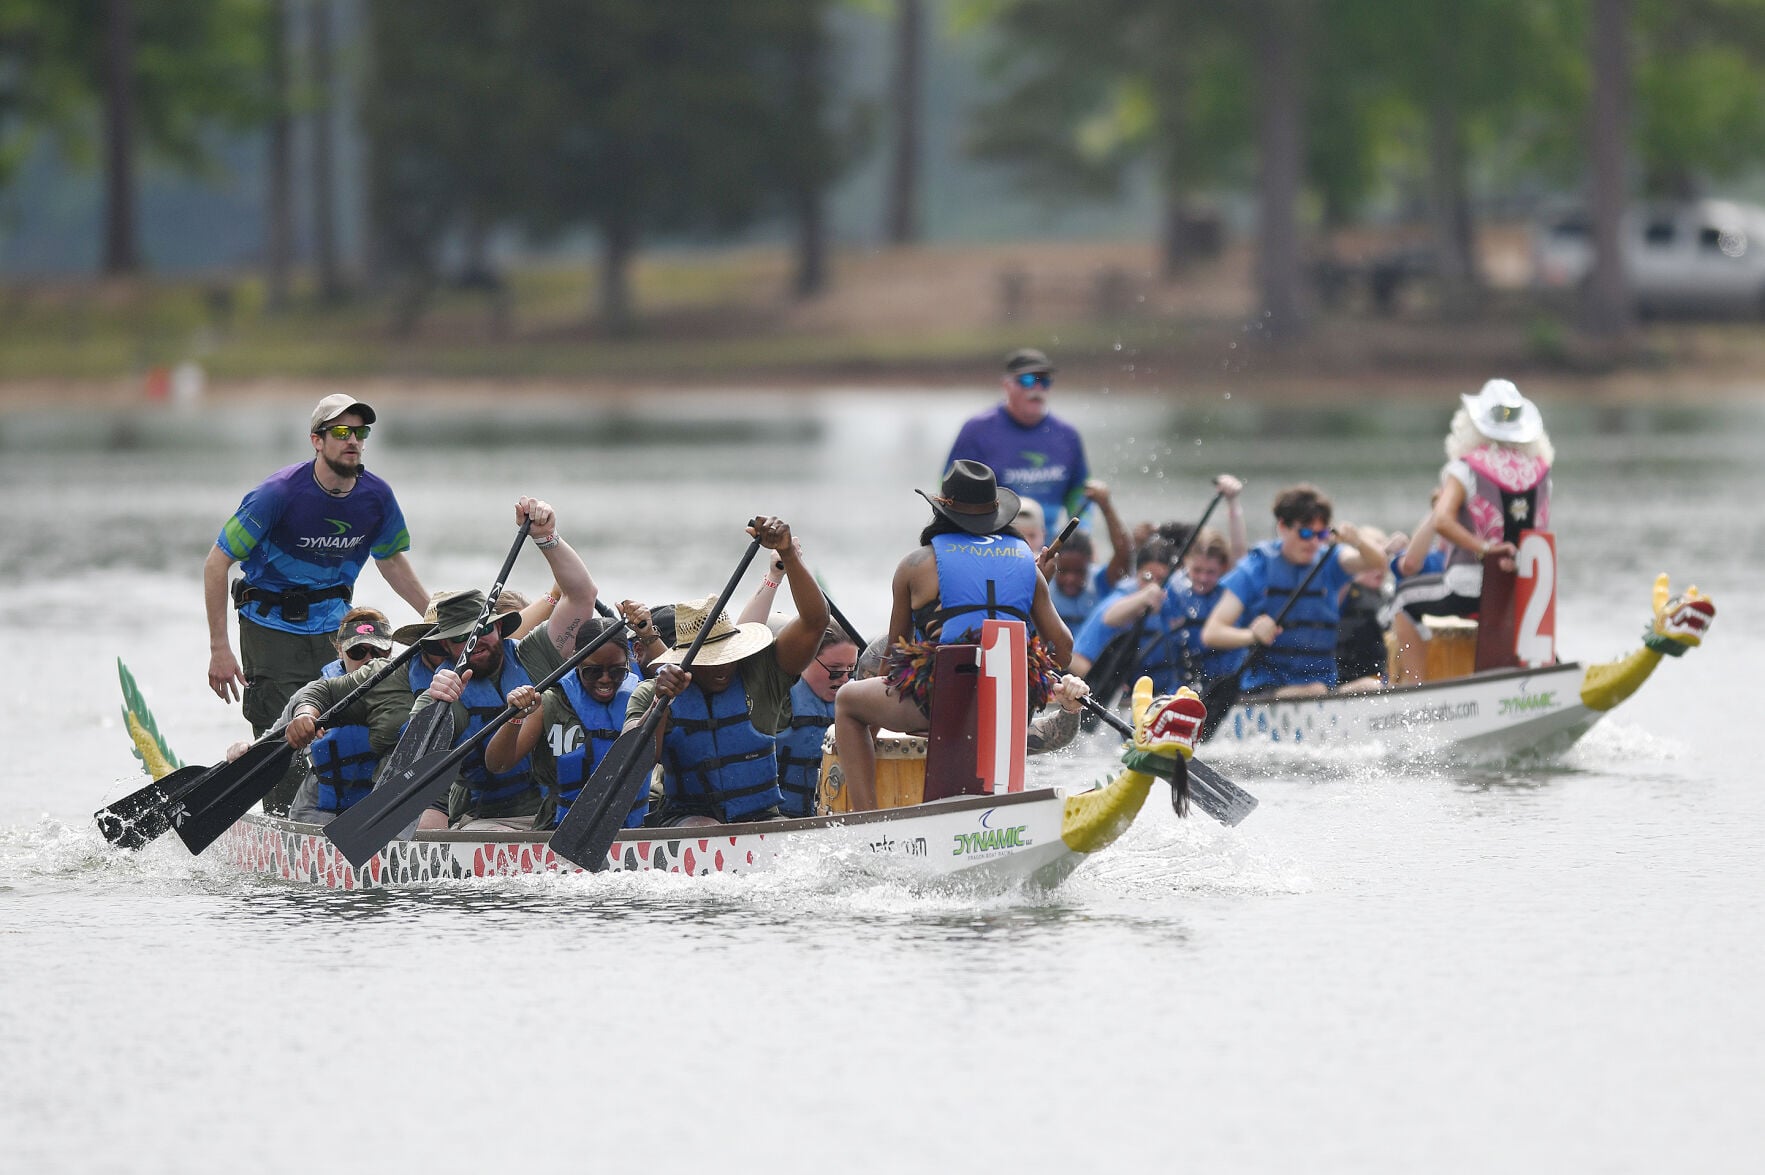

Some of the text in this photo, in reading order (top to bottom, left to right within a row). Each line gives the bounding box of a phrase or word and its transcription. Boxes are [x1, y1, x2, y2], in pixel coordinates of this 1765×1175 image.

[945, 543, 1026, 559] DYNAMIC
[456, 581, 504, 668] KIALOA
[1515, 534, 1555, 669] 2
[985, 627, 1013, 795] 1
[952, 826, 1026, 856] DYNAMIC
